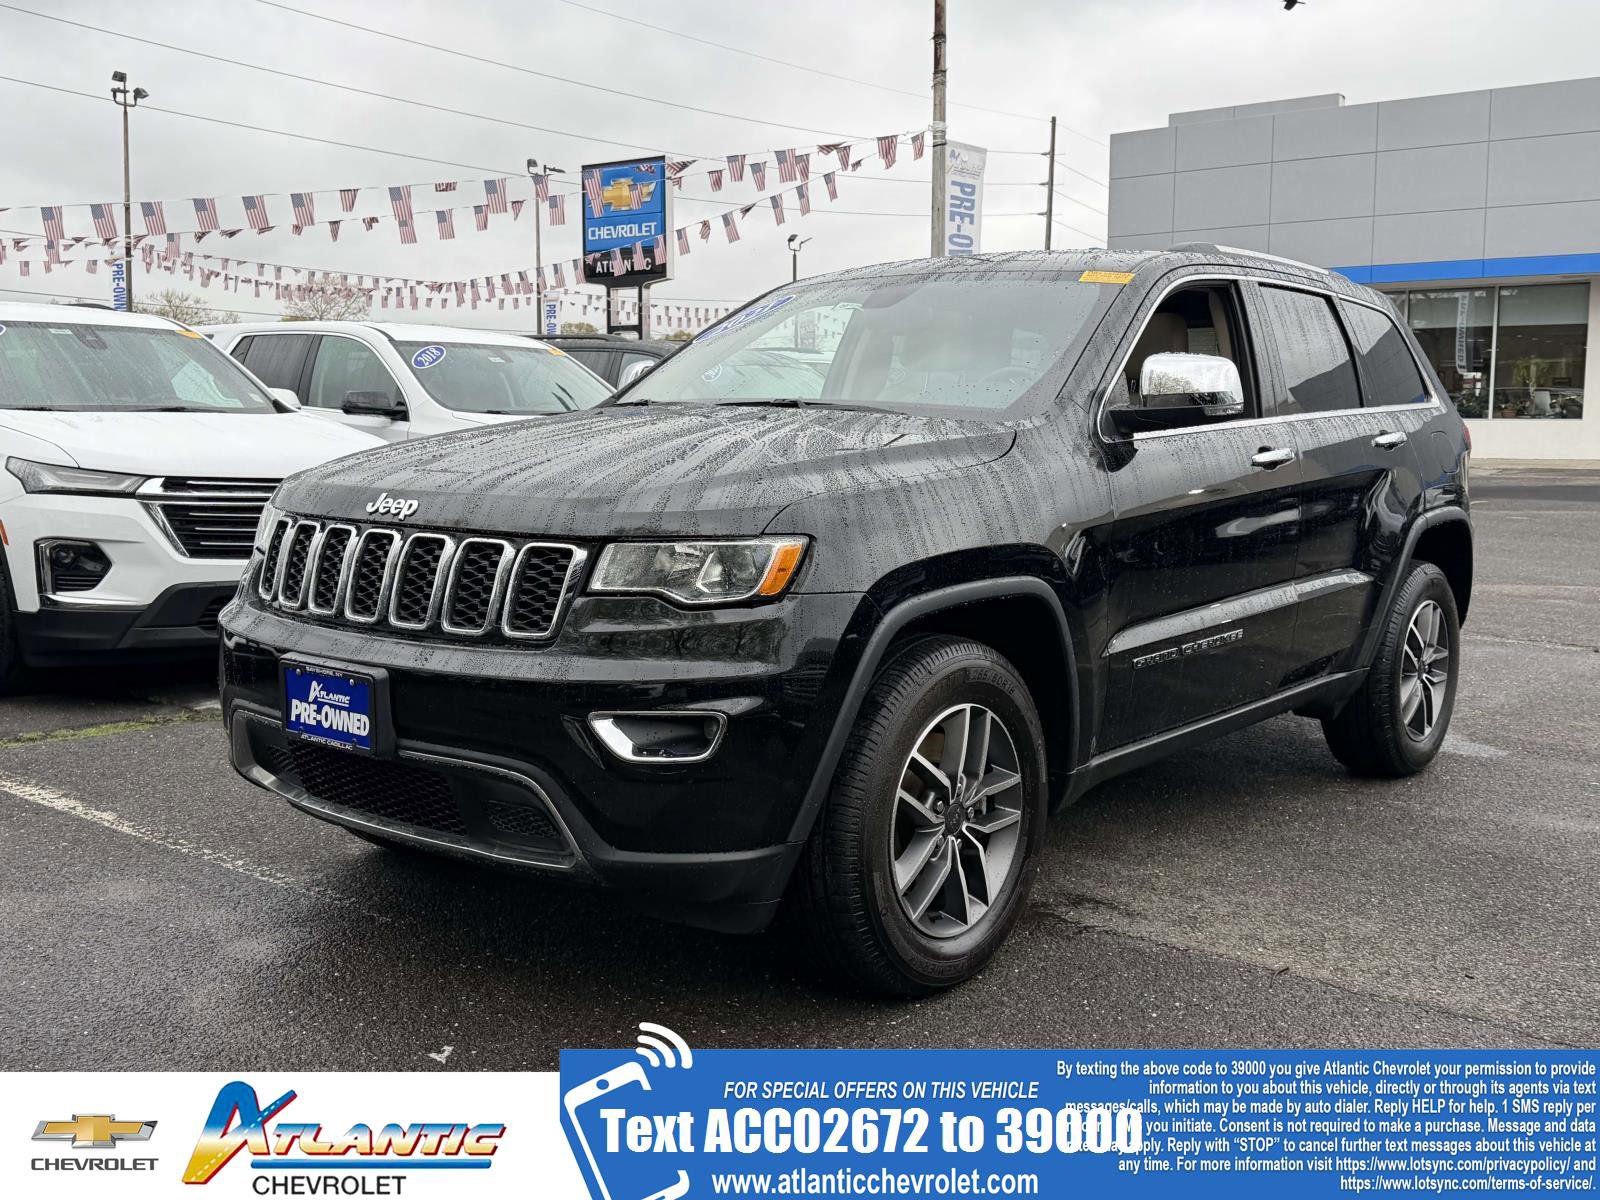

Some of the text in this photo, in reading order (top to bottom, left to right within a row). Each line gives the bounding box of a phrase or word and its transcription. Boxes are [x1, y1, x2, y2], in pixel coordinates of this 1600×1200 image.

[948, 180, 976, 256] PRE-O
[588, 222, 657, 240] CHEVROLET
[595, 257, 652, 274] ATLNC
[417, 347, 441, 367] 2018
[365, 492, 419, 521] Jeep
[1133, 628, 1244, 669] GRAND CHEROKEE
[308, 680, 351, 703] ATLANTIC
[290, 698, 370, 737] PRE-OWNED
[300, 733, 353, 751] ATLANTIC CADILLAC
